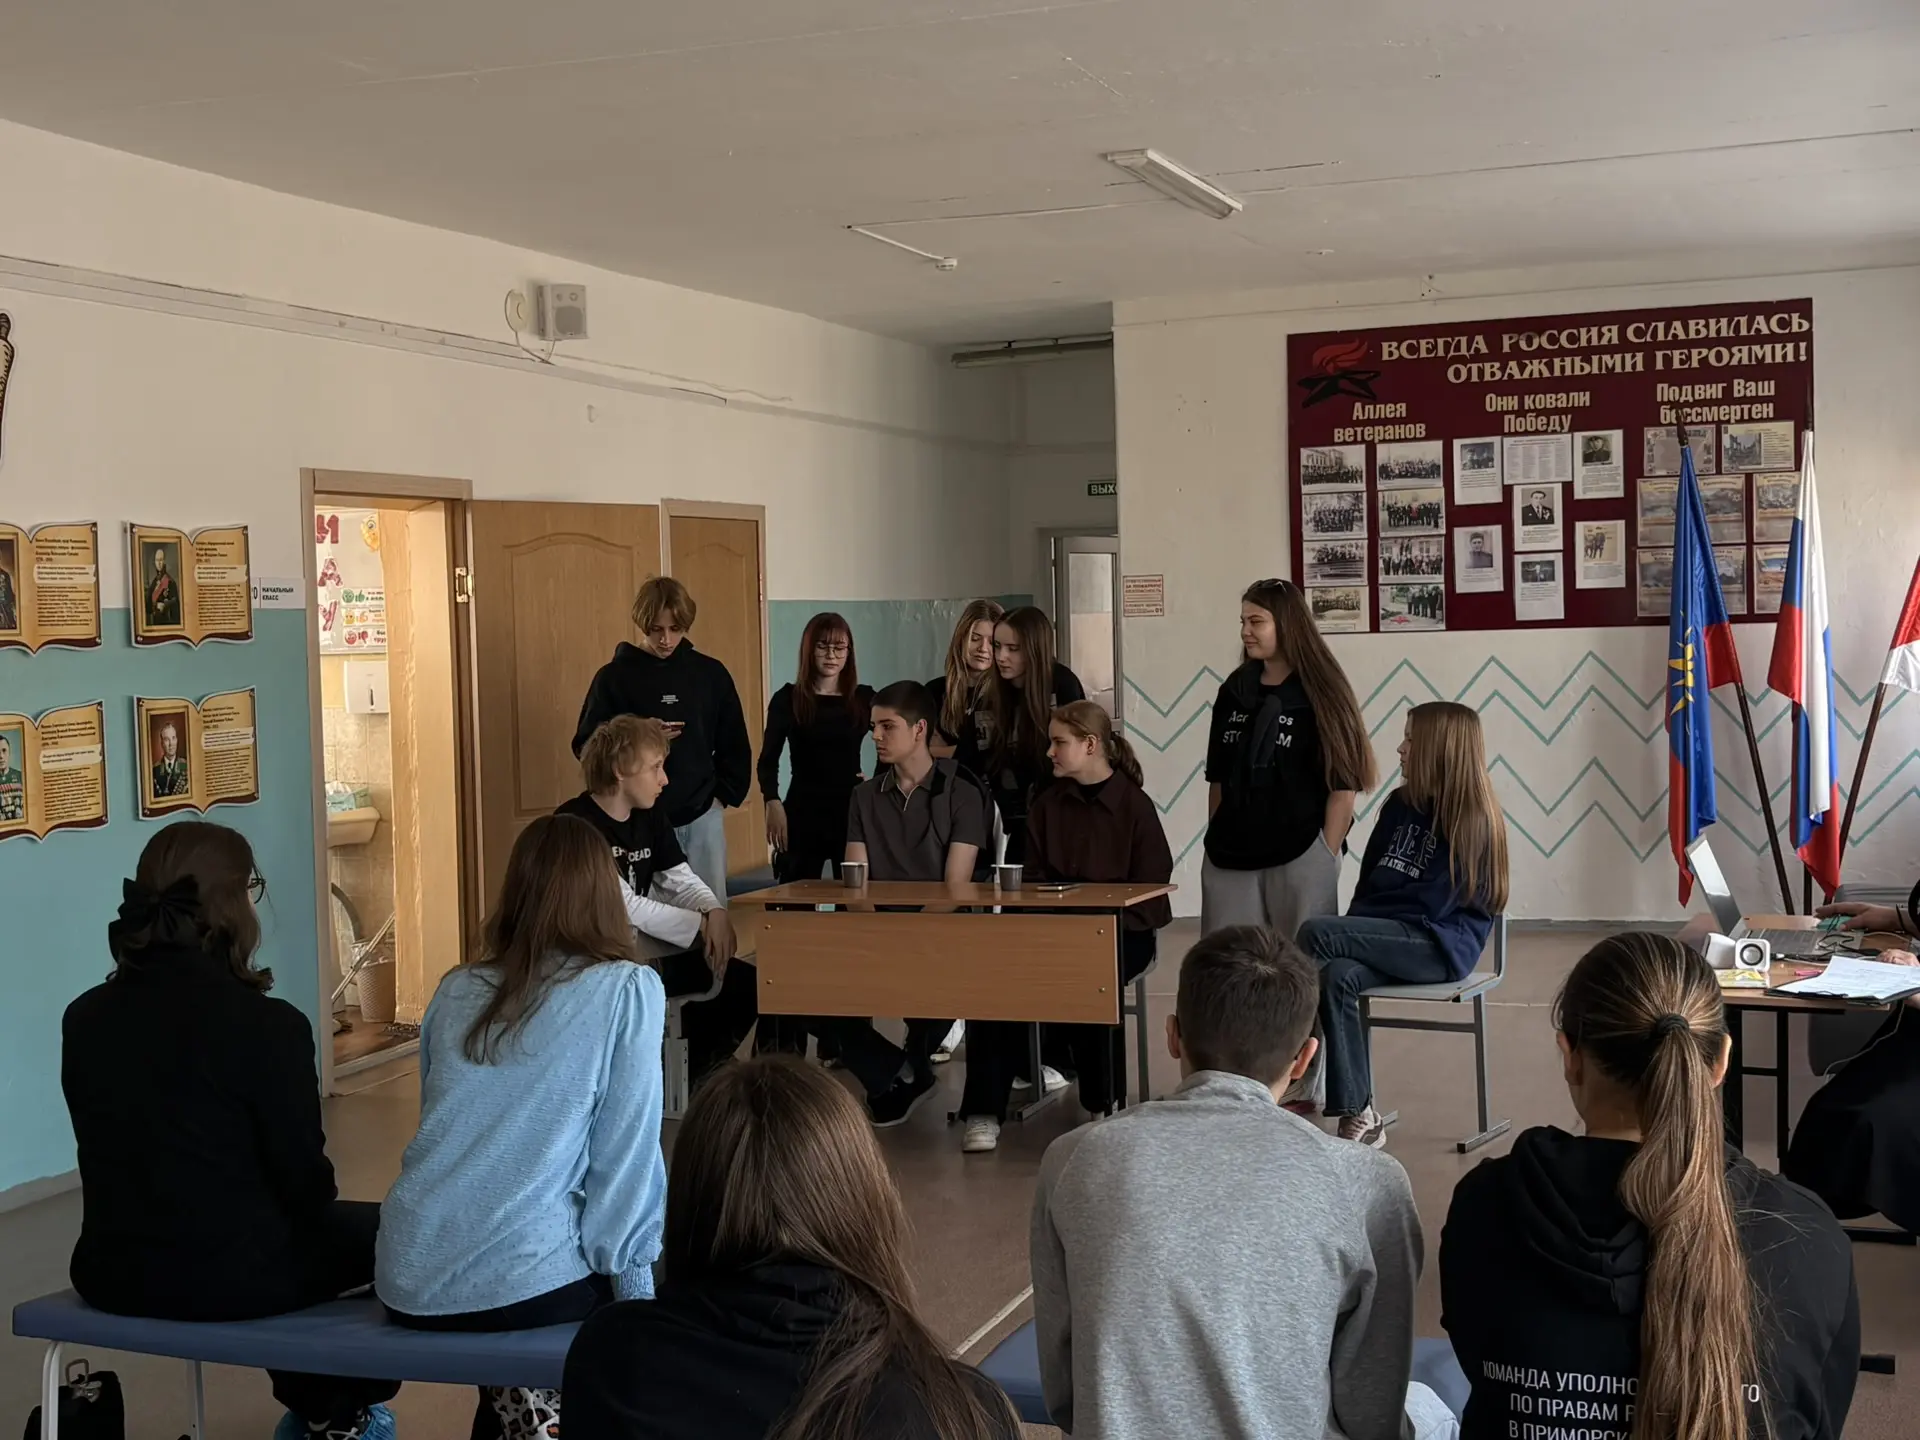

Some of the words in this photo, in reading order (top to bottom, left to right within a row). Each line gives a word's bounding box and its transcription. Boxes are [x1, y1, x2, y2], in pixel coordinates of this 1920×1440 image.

[1381, 334, 1489, 361] ВСЕГДА
[1502, 325, 1619, 353] РОССИЯ
[1626, 313, 1810, 342] СЛАВИЛАСЬ
[1447, 351, 1644, 383] ОТВАЖНЫМИ
[1655, 342, 1807, 371] ГЕРОЯМИ!
[1656, 382, 1727, 403] Подвиг
[1733, 378, 1775, 398] Ваш
[1352, 402, 1407, 420] Аллея
[1485, 393, 1518, 411] Они
[1524, 391, 1590, 410] ковали
[1334, 423, 1426, 443] ветеранов
[1504, 413, 1572, 433] Победу
[1091, 484, 1116, 495] ВЫХ
[1483, 1360, 1550, 1390] КОМАНДА
[1510, 1393, 1532, 1414] ПО
[1538, 1397, 1618, 1421] ПРАВАМ
[1509, 1420, 1519, 1438] В
